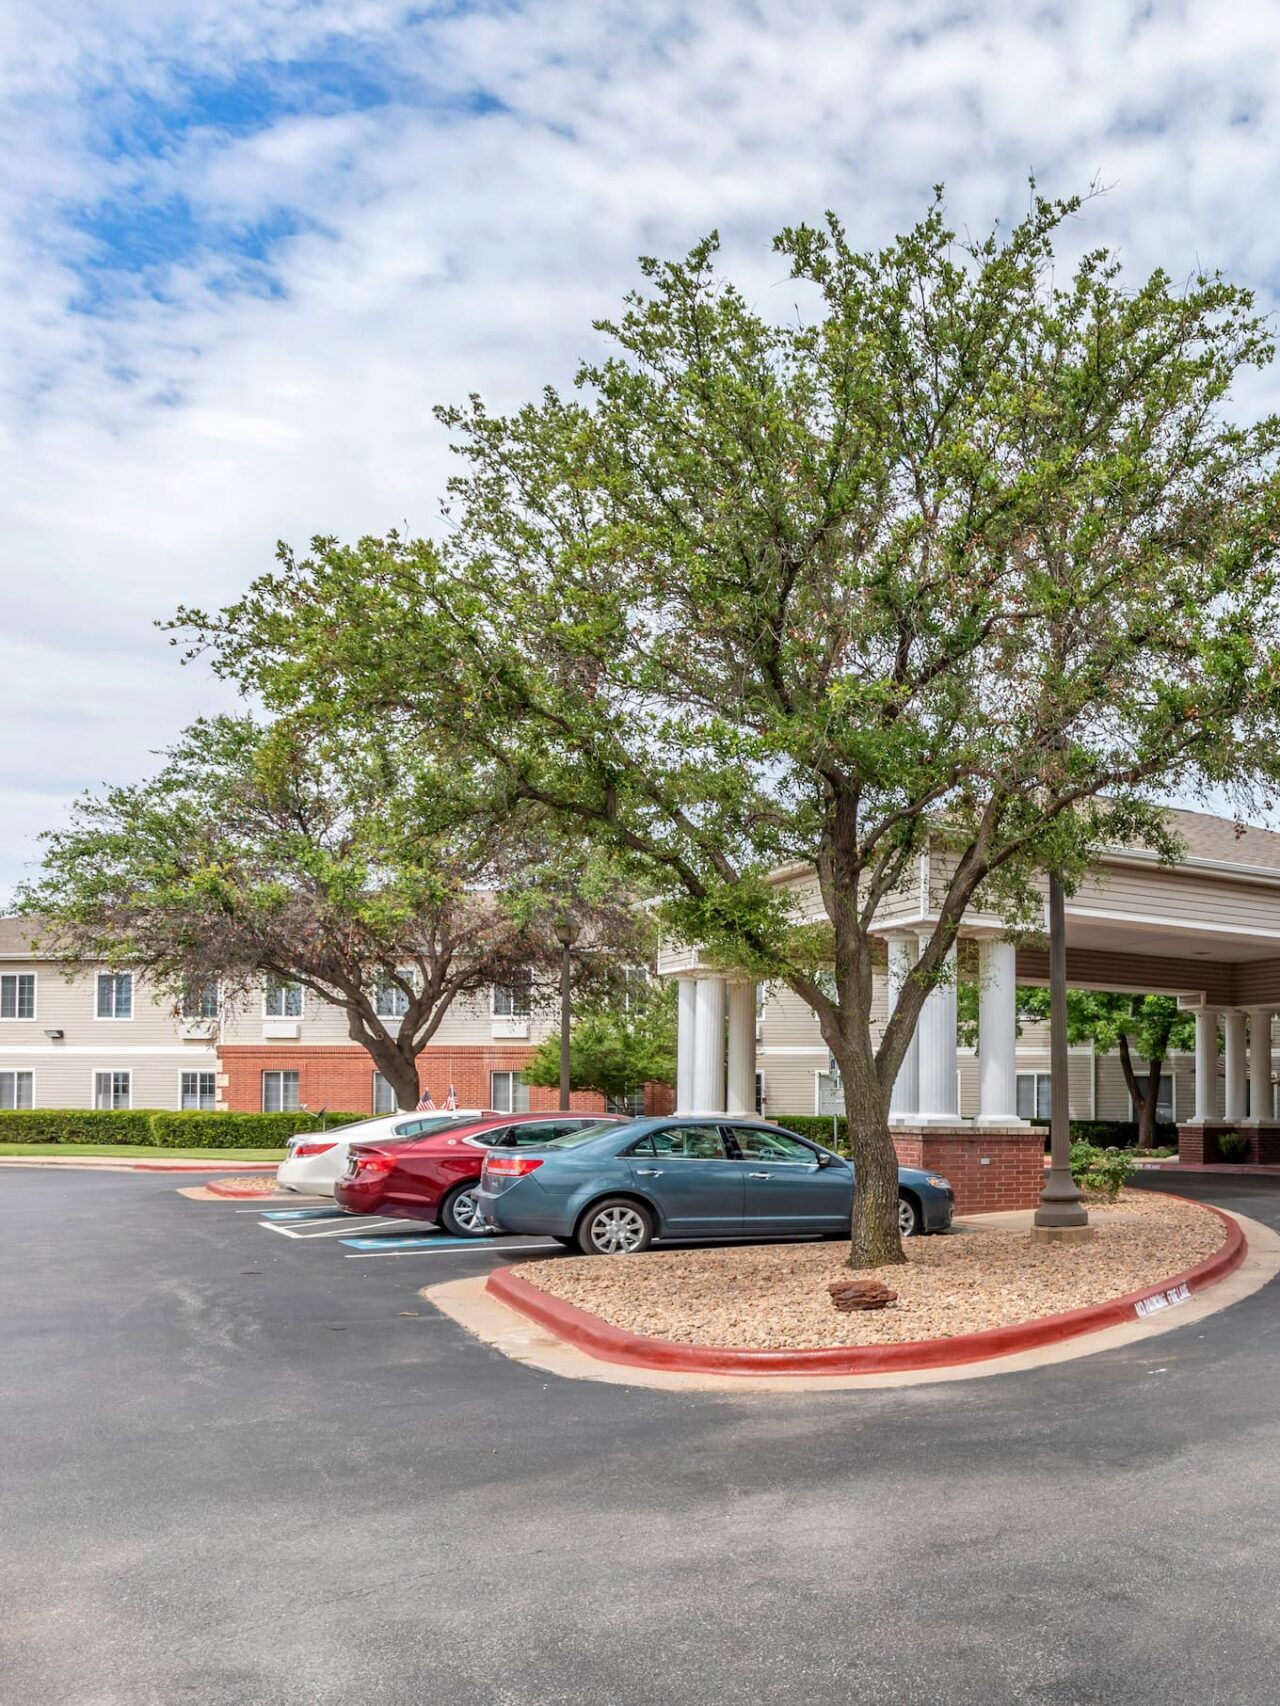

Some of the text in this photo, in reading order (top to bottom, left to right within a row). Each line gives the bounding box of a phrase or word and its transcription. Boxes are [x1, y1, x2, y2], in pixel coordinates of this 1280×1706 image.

[1134, 1282, 1191, 1318] NO PARKING FIRE LANE
